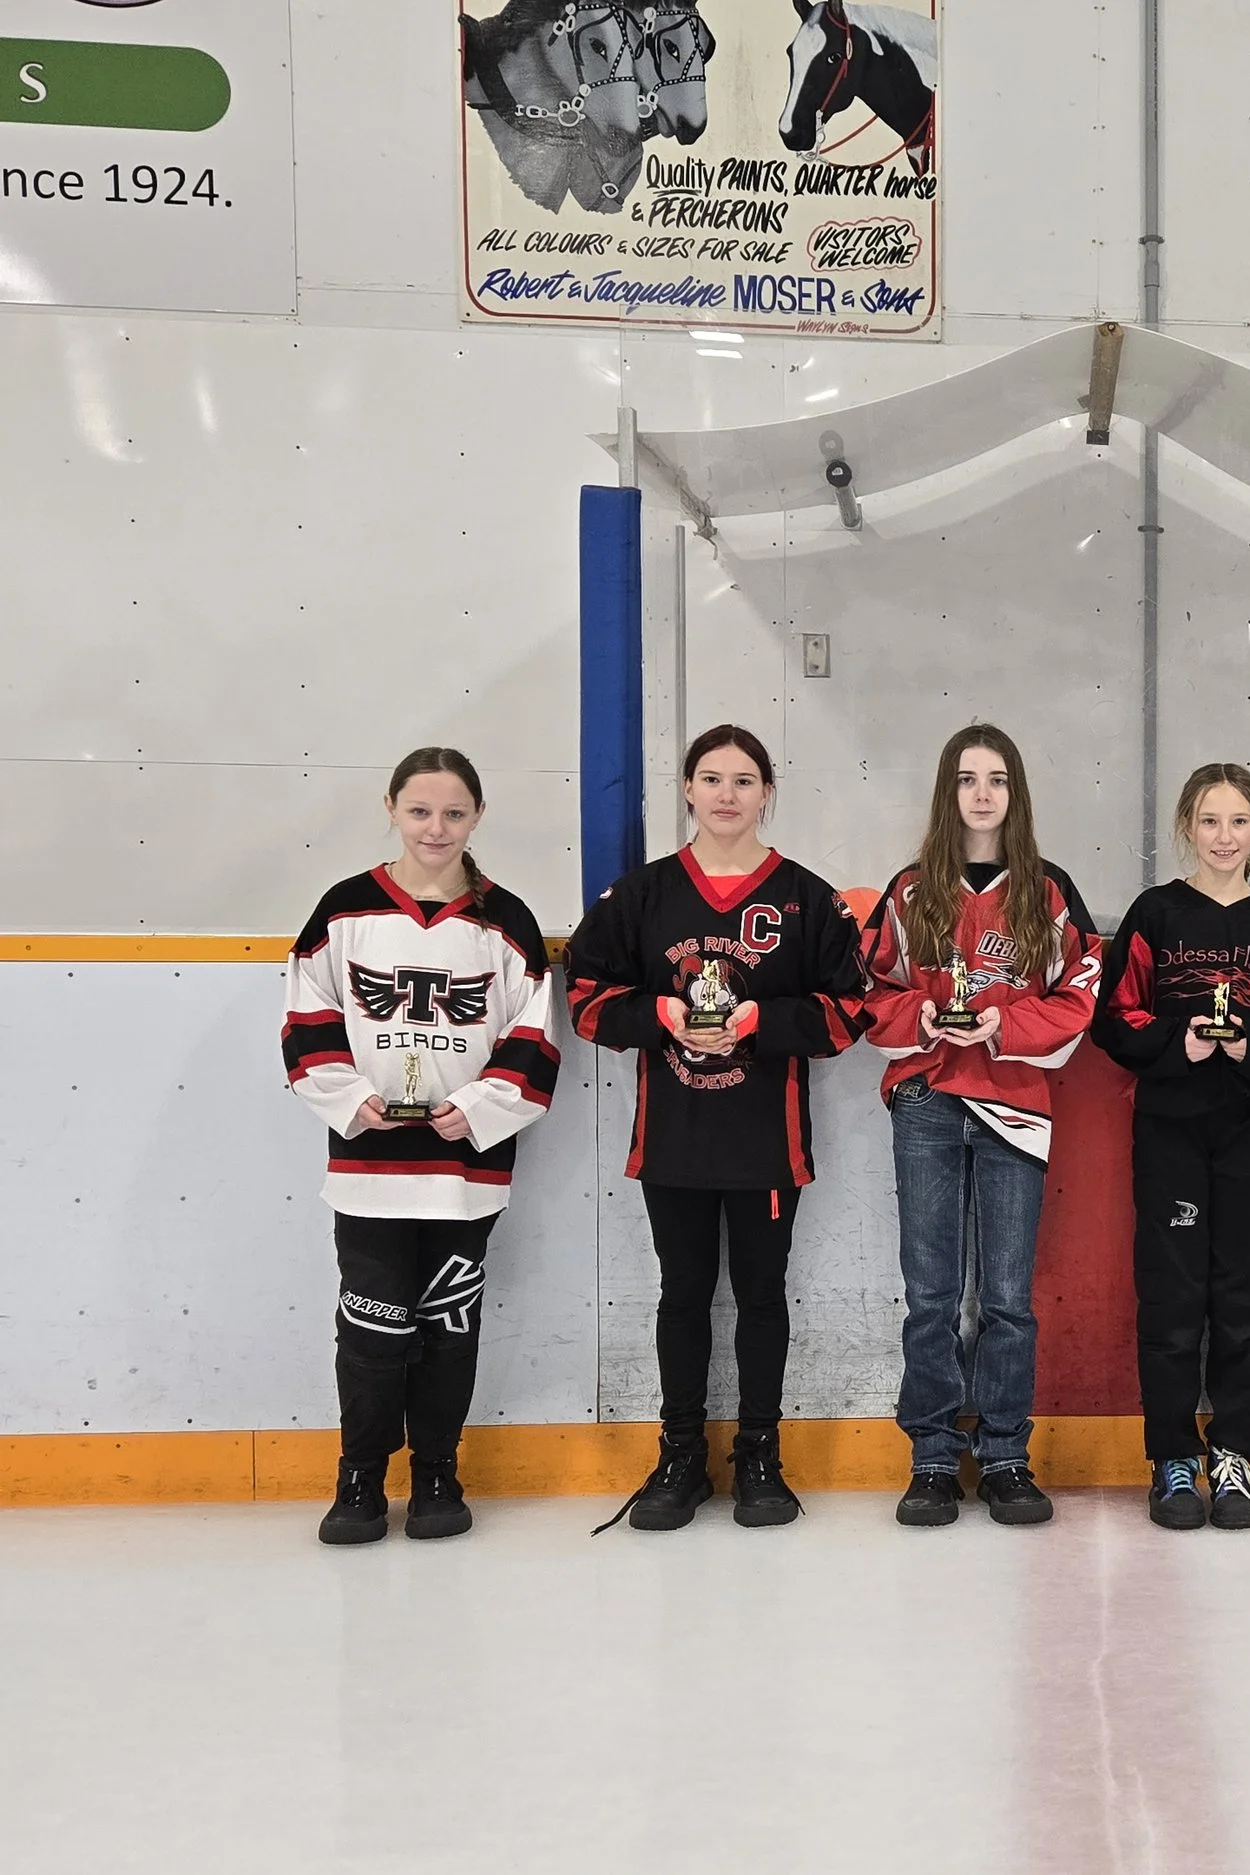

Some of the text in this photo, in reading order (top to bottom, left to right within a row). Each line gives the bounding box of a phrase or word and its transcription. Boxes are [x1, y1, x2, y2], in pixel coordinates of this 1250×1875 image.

[19, 61, 48, 103] S
[2, 164, 233, 208] nce 1924.
[646, 154, 937, 200] Quality PAINTS, QUARTER horse
[631, 197, 789, 234] & PERCHERONS
[477, 228, 793, 264] ALL COLOURS & SIZES FOR SALE
[813, 224, 910, 251] VISITORS
[817, 242, 917, 268] WELCOME
[477, 268, 925, 316] Robert & Jacqueline MOSER & Sons
[740, 904, 782, 953] C
[665, 936, 761, 970] BIG RIVER
[393, 965, 453, 1027] T
[1068, 954, 1102, 1000] 2
[376, 1032, 468, 1054] BIRDS
